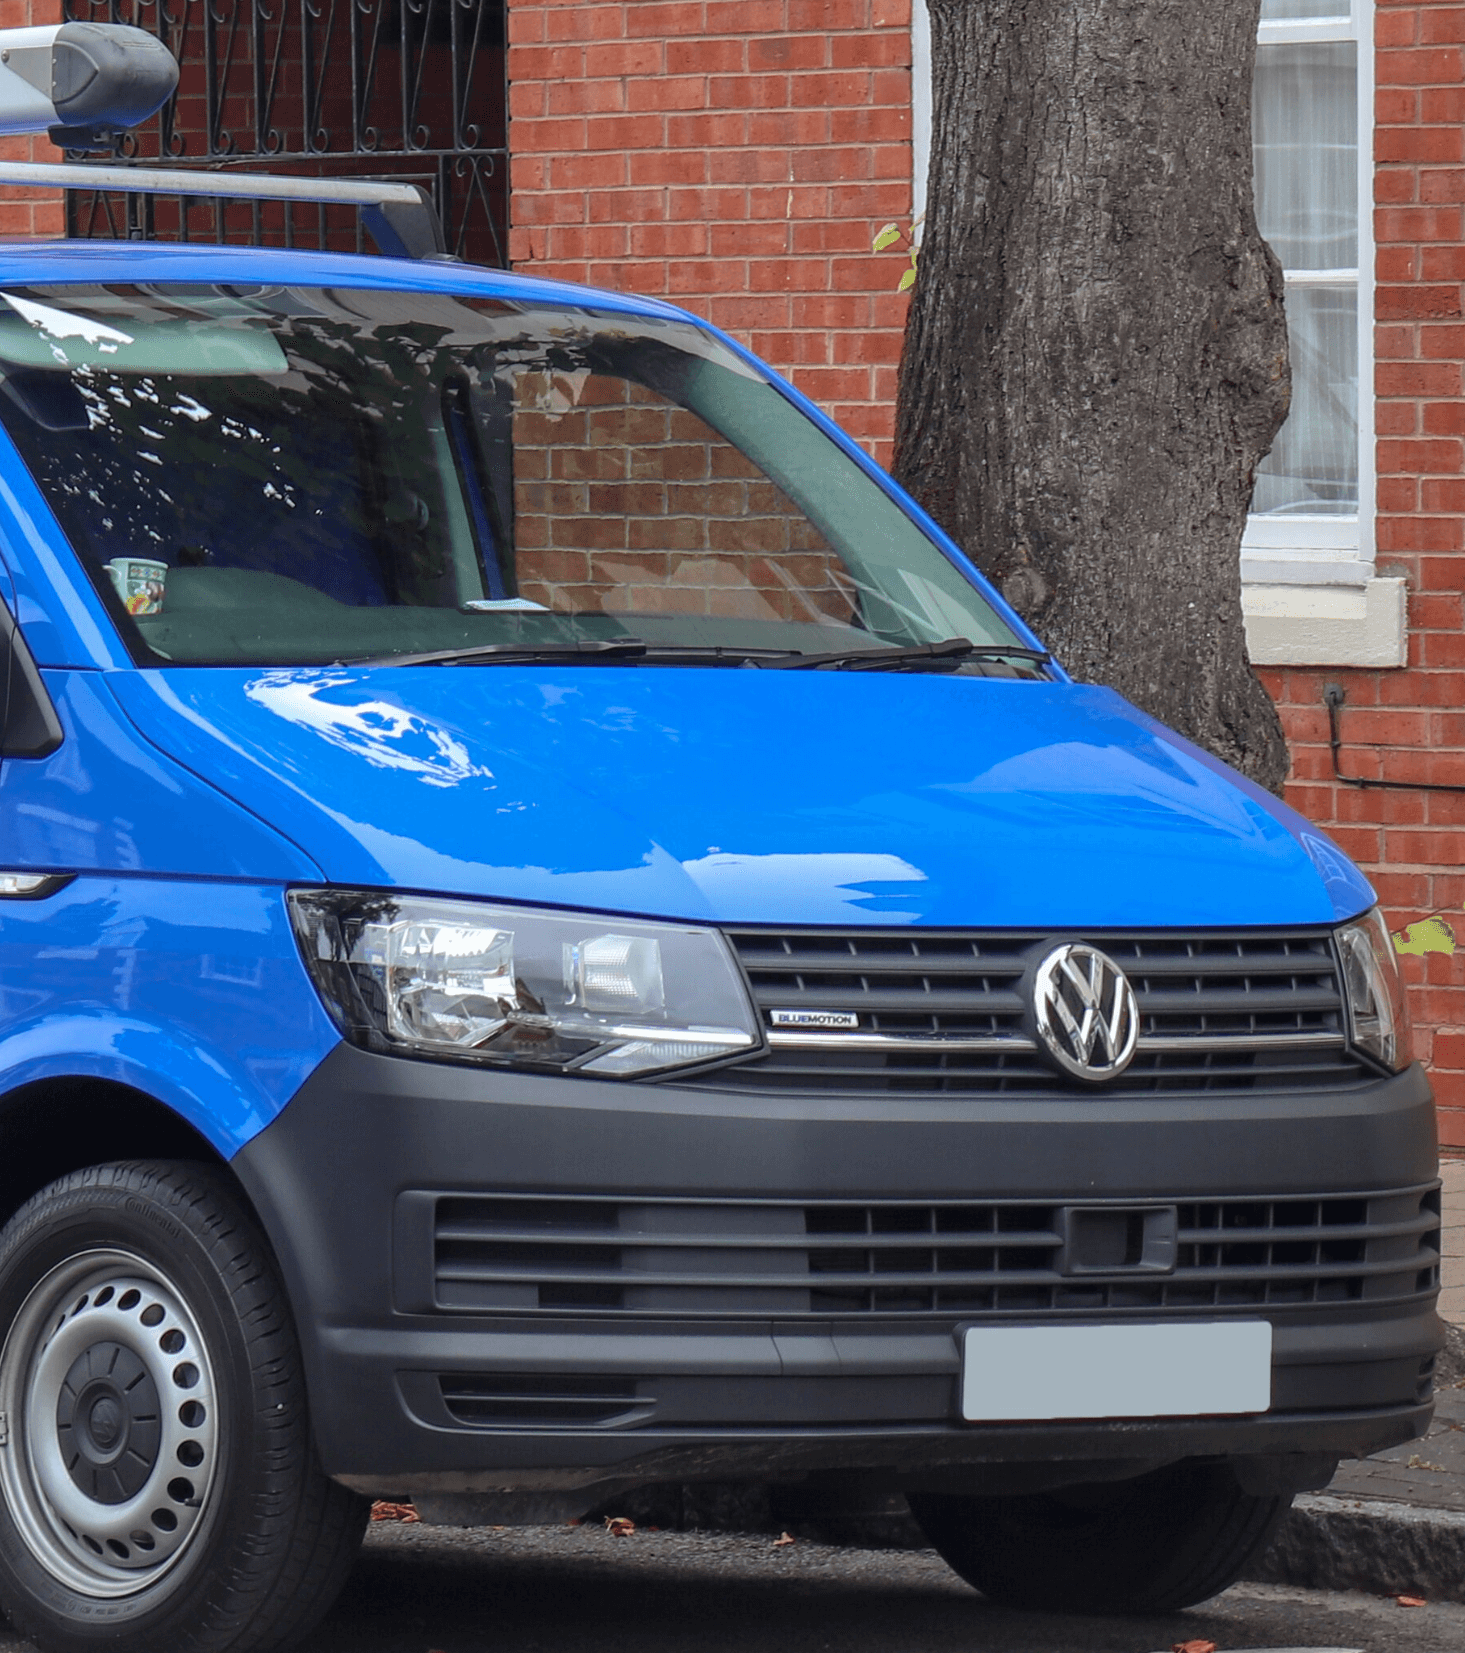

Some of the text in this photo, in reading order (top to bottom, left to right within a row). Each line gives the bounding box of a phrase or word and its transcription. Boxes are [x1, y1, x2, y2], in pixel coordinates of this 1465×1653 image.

[778, 1014, 852, 1025] BLUEMOTION
[1043, 951, 1127, 1070] VW
[125, 1196, 182, 1239] Continental
